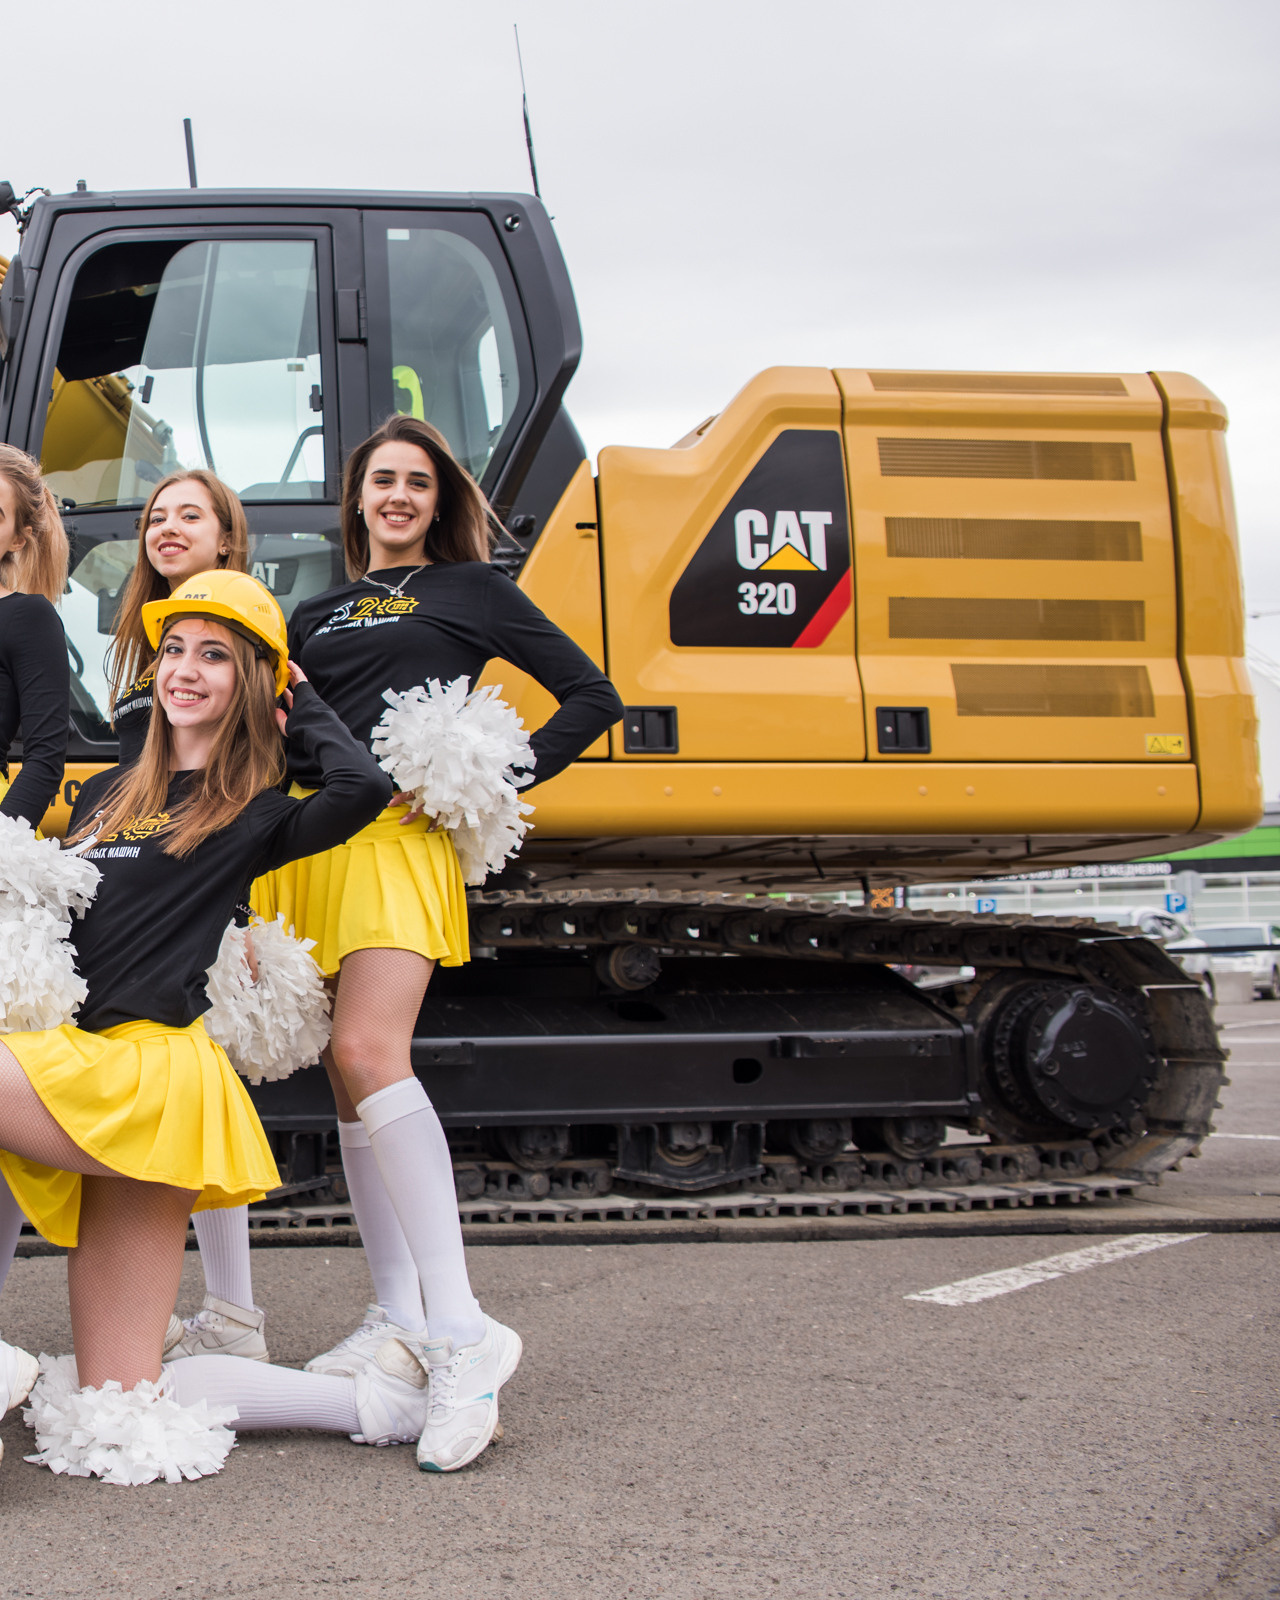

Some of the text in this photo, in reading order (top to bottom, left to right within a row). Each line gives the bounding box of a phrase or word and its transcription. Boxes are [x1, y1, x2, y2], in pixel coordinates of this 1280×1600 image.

[734, 509, 833, 572] CAT
[251, 562, 280, 590] AT
[737, 582, 797, 616] 320
[81, 846, 141, 859] МНЫХ МАШИН
